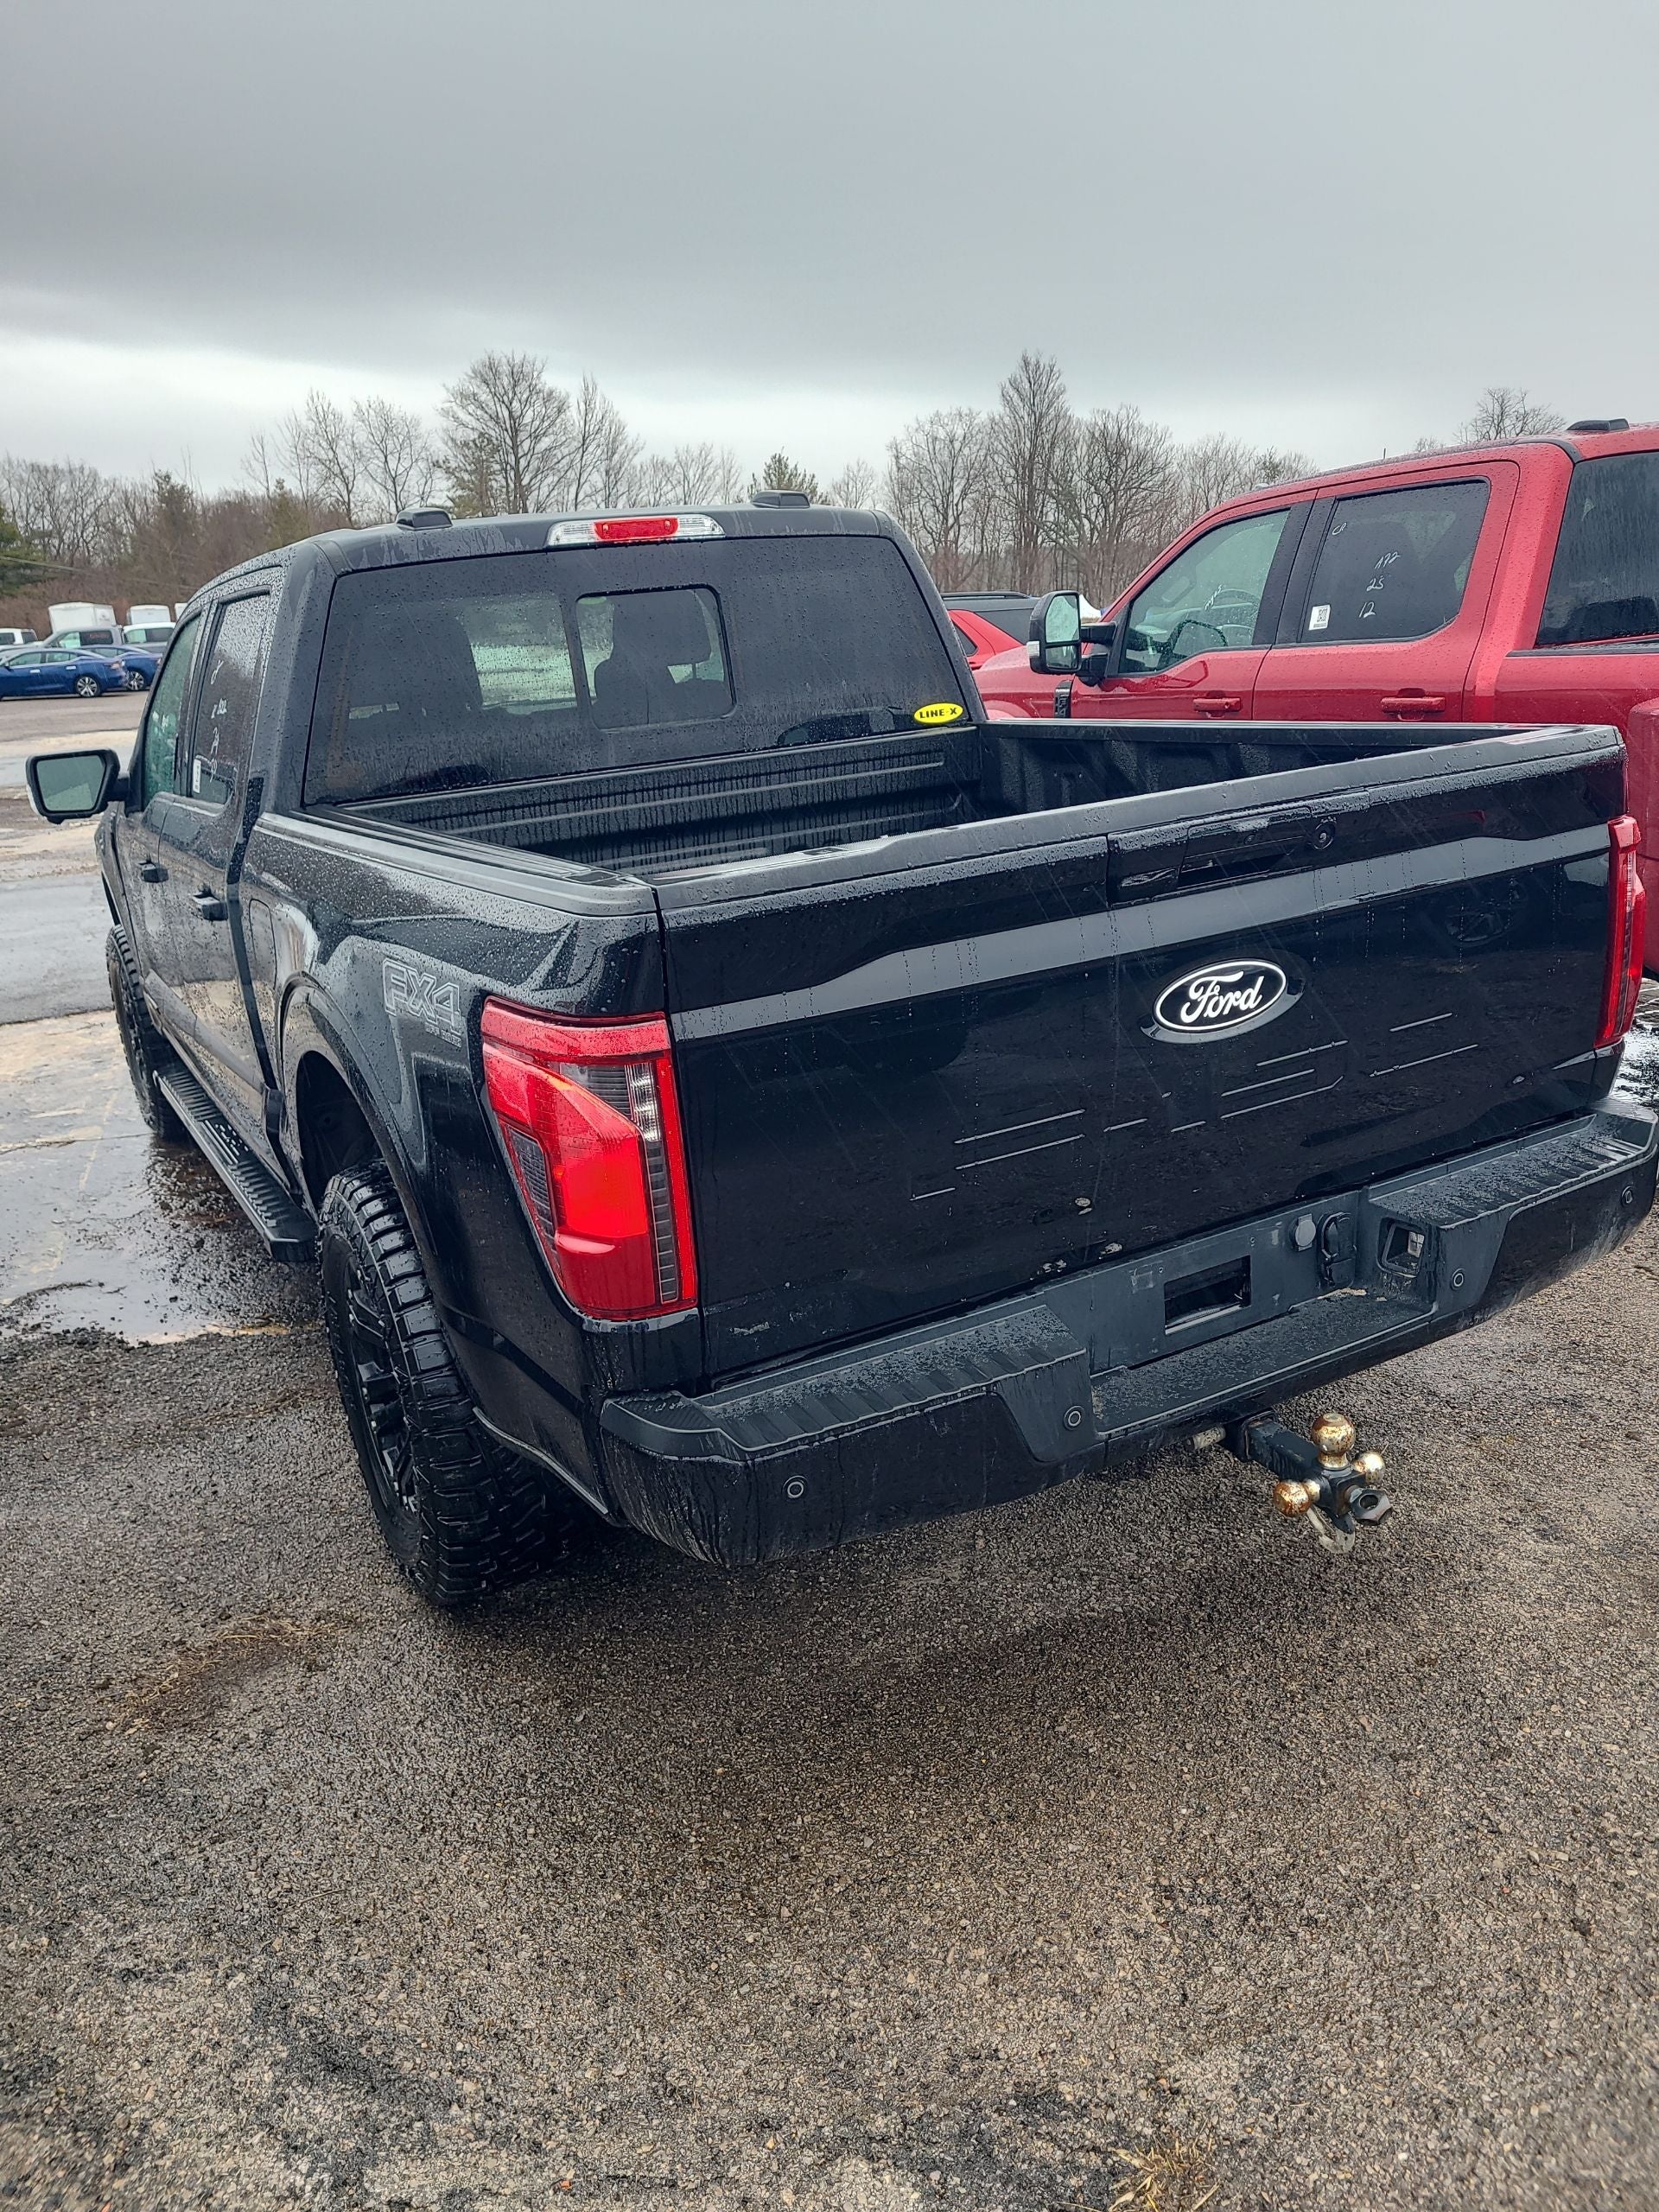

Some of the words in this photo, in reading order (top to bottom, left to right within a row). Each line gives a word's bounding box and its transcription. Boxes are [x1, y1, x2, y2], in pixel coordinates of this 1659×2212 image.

[1358, 602, 1376, 618] 12
[383, 958, 461, 1036] FX4
[1180, 970, 1265, 1023] Ford
